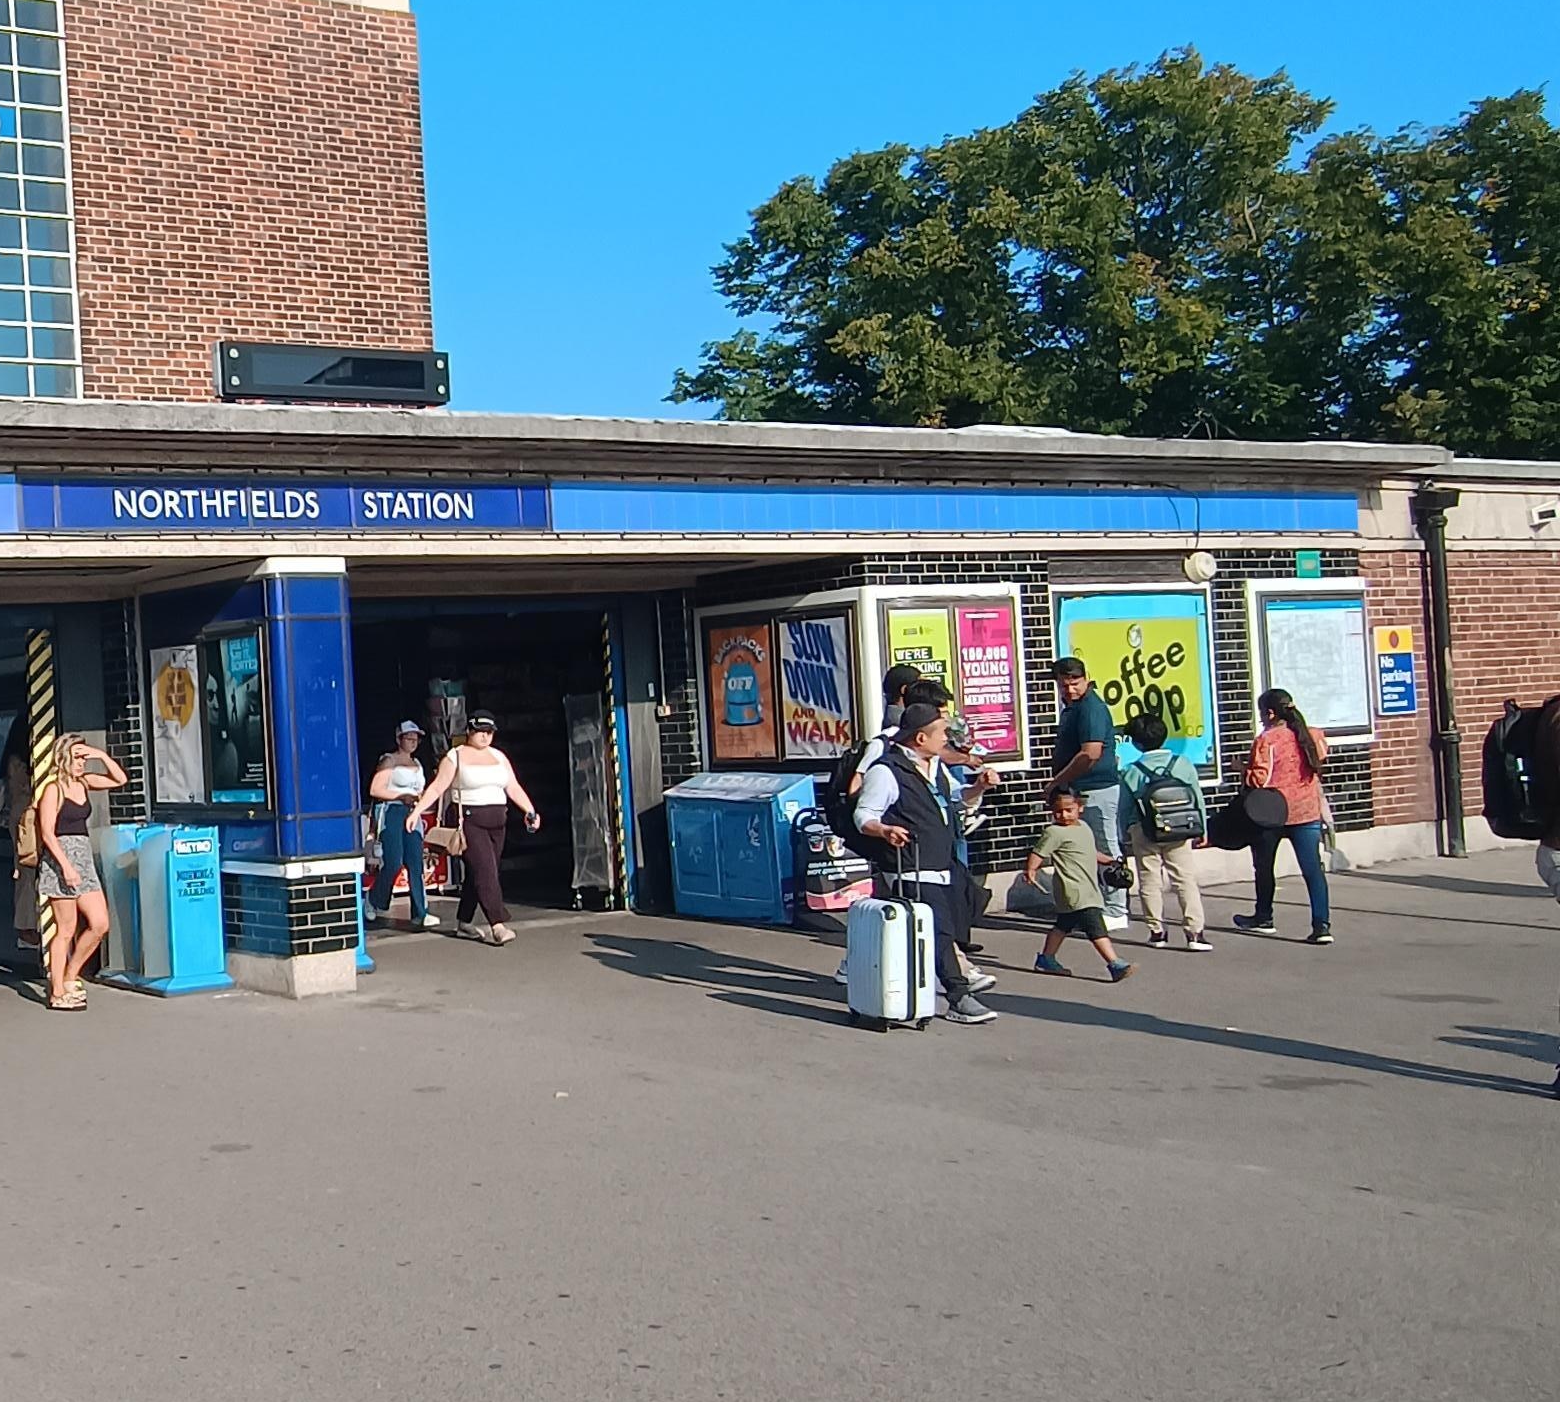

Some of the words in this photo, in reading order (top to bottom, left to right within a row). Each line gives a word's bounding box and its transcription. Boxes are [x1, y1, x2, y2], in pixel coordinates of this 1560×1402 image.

[114, 489, 320, 519] NORTHFIELDS
[363, 491, 474, 520] STATION
[714, 635, 766, 664] BACKPACKS
[787, 621, 838, 666] SLOW
[895, 648, 929, 660] WE'RE
[963, 661, 1010, 677] YOUNG
[1089, 642, 1185, 706] offee
[727, 677, 753, 690] OFF
[782, 658, 842, 715] DOWN
[792, 707, 816, 719] AND
[786, 719, 850, 746] WALK
